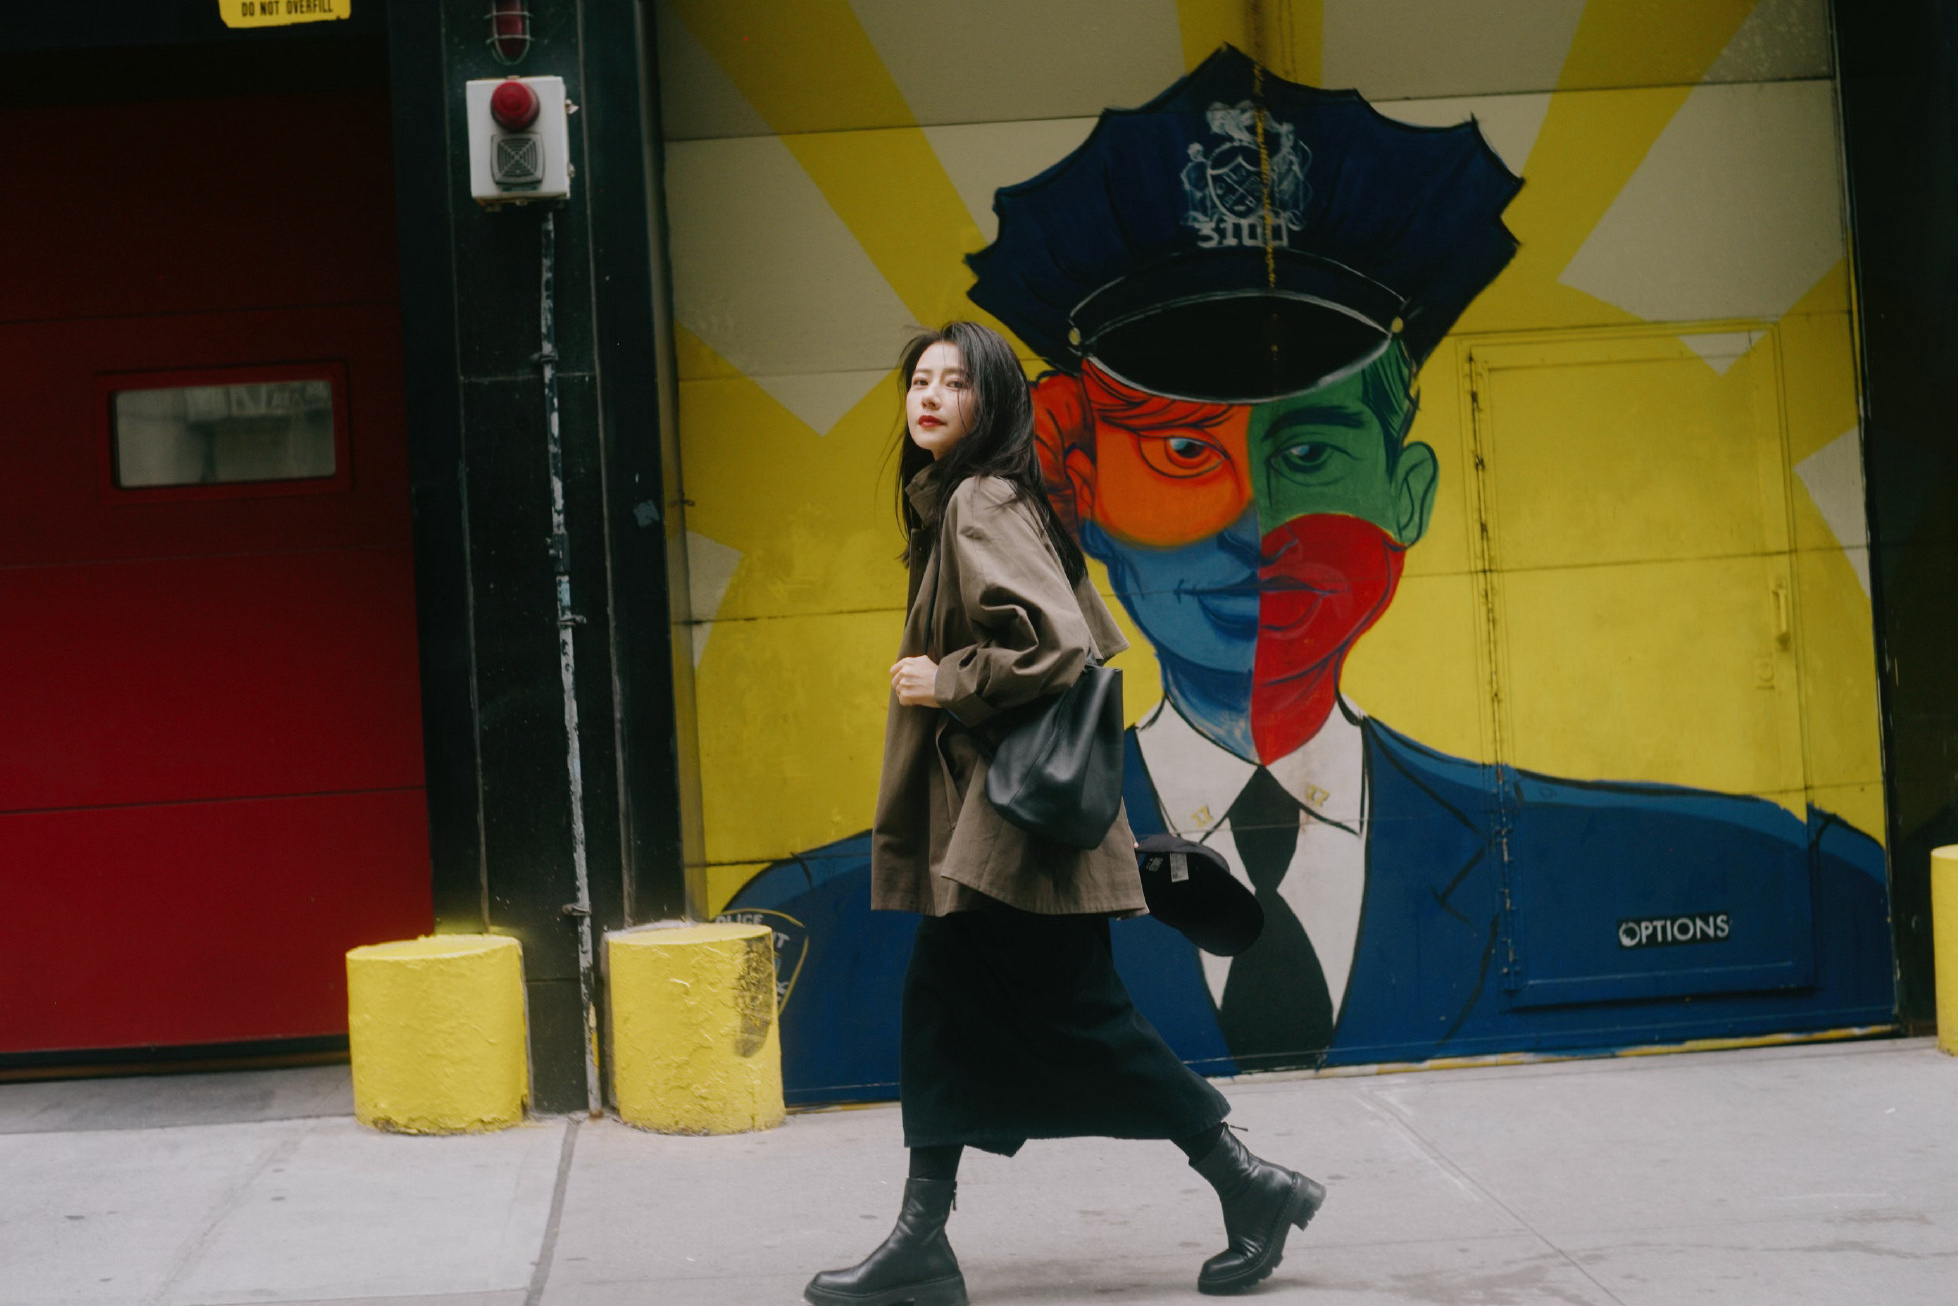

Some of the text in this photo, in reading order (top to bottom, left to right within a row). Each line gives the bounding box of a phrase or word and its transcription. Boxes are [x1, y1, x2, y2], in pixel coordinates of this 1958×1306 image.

[241, 0, 334, 17] DO NOT OVERFILL
[1190, 804, 1214, 828] 17
[1618, 914, 1730, 948] OPTIONS
